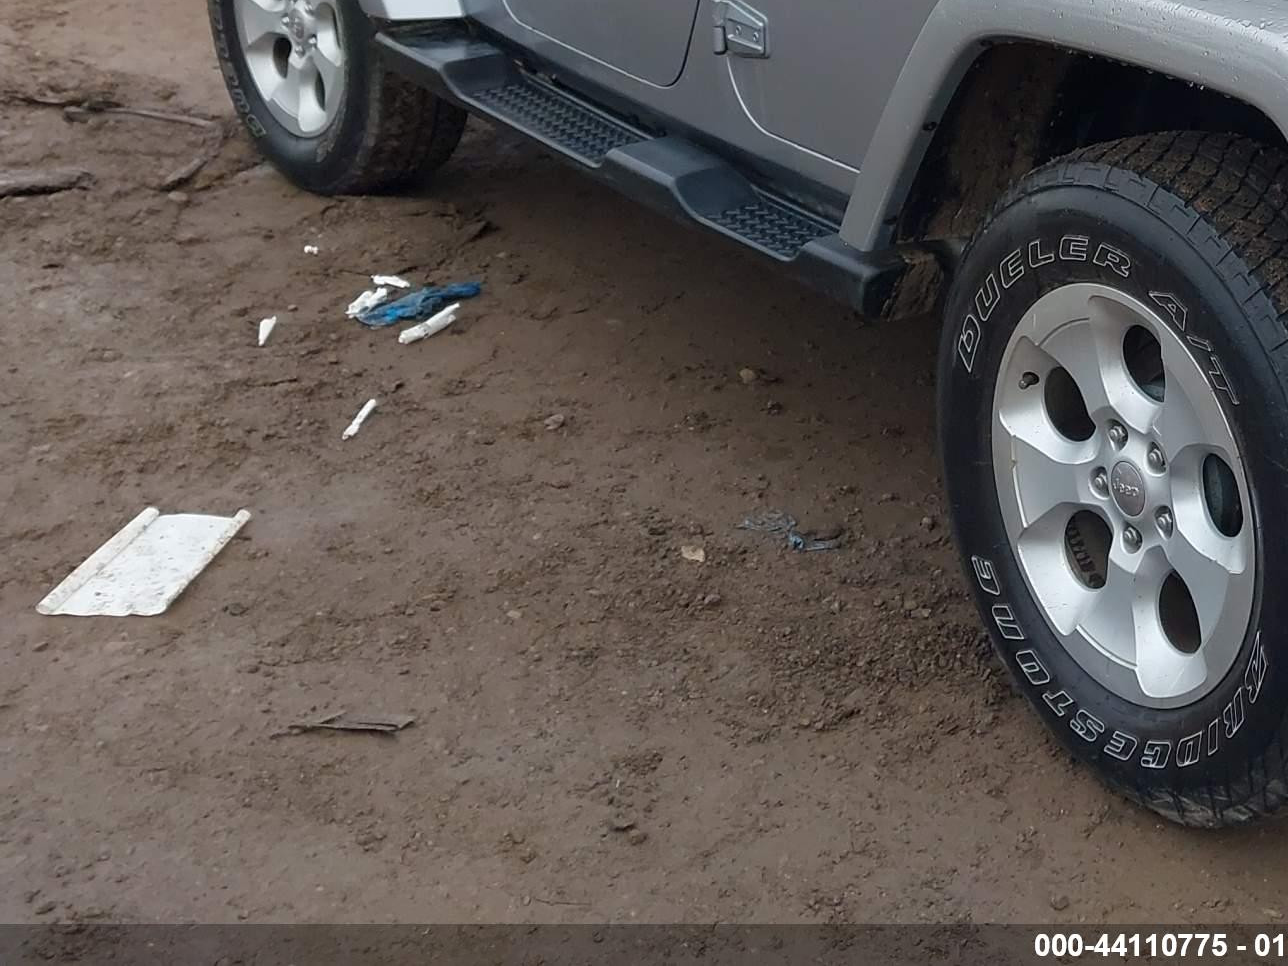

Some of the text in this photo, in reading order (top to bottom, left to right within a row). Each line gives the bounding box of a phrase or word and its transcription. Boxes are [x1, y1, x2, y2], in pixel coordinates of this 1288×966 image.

[958, 235, 1241, 405] DUELER A/T
[1112, 477, 1140, 497] Jeep
[971, 554, 1269, 769] BRIDGESTONE
